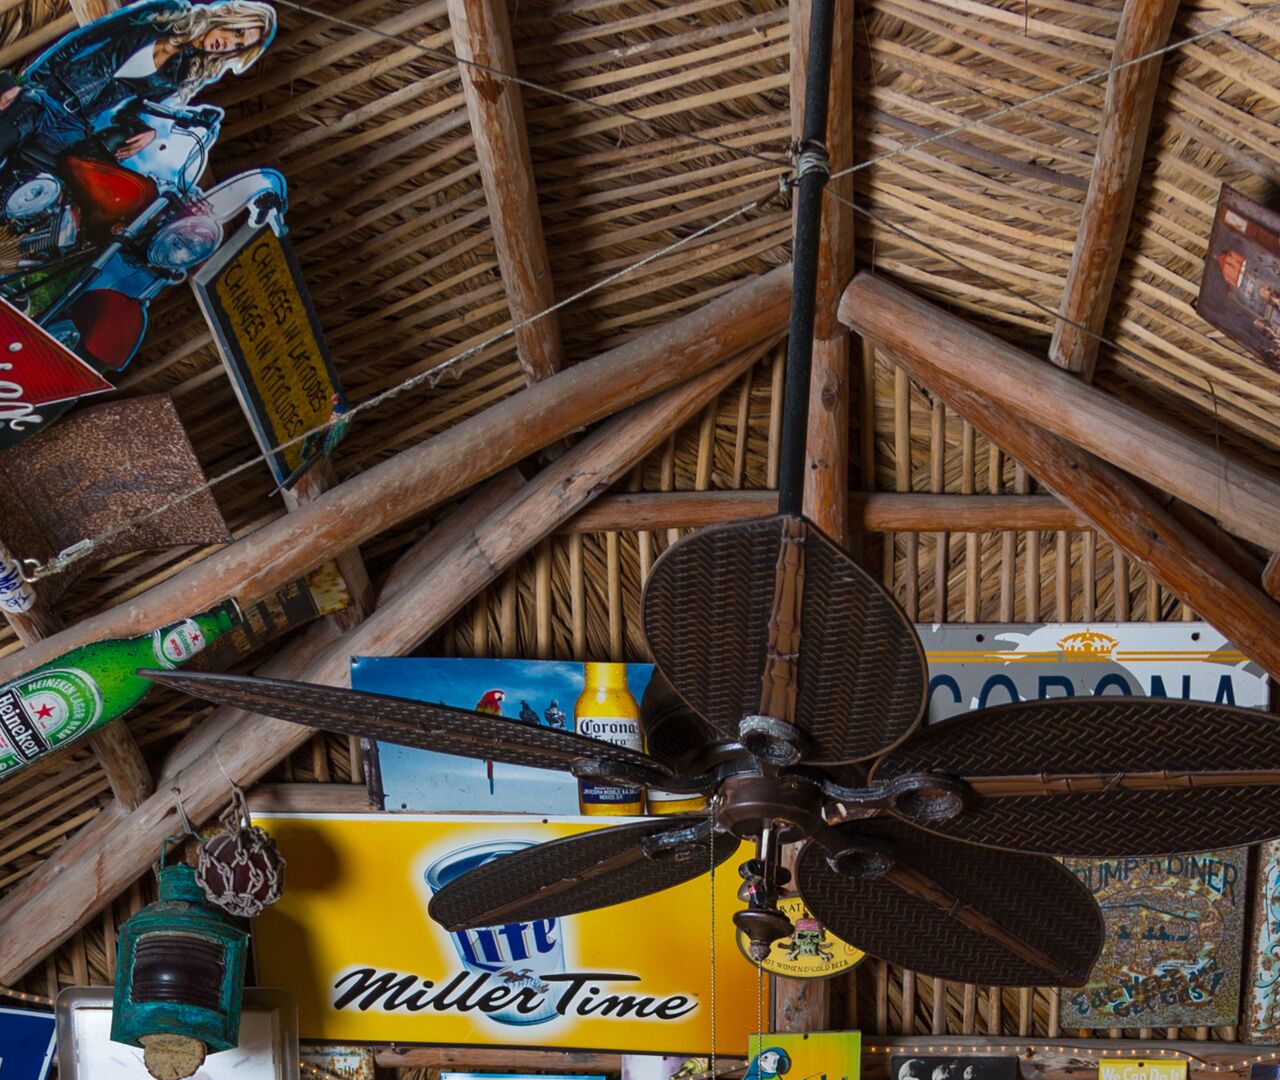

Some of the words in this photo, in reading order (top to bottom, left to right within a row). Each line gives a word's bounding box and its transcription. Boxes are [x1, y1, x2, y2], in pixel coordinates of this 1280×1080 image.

[224, 263, 266, 342] CHANGES
[251, 242, 293, 325] CHANGES
[282, 321, 301, 345] IN
[256, 335, 271, 361] IN
[261, 356, 304, 438] ATTITUDES
[579, 719, 637, 735] Corona
[1167, 854, 1238, 907] DINER
[334, 967, 545, 1017] Miller
[539, 973, 699, 1020] Time
